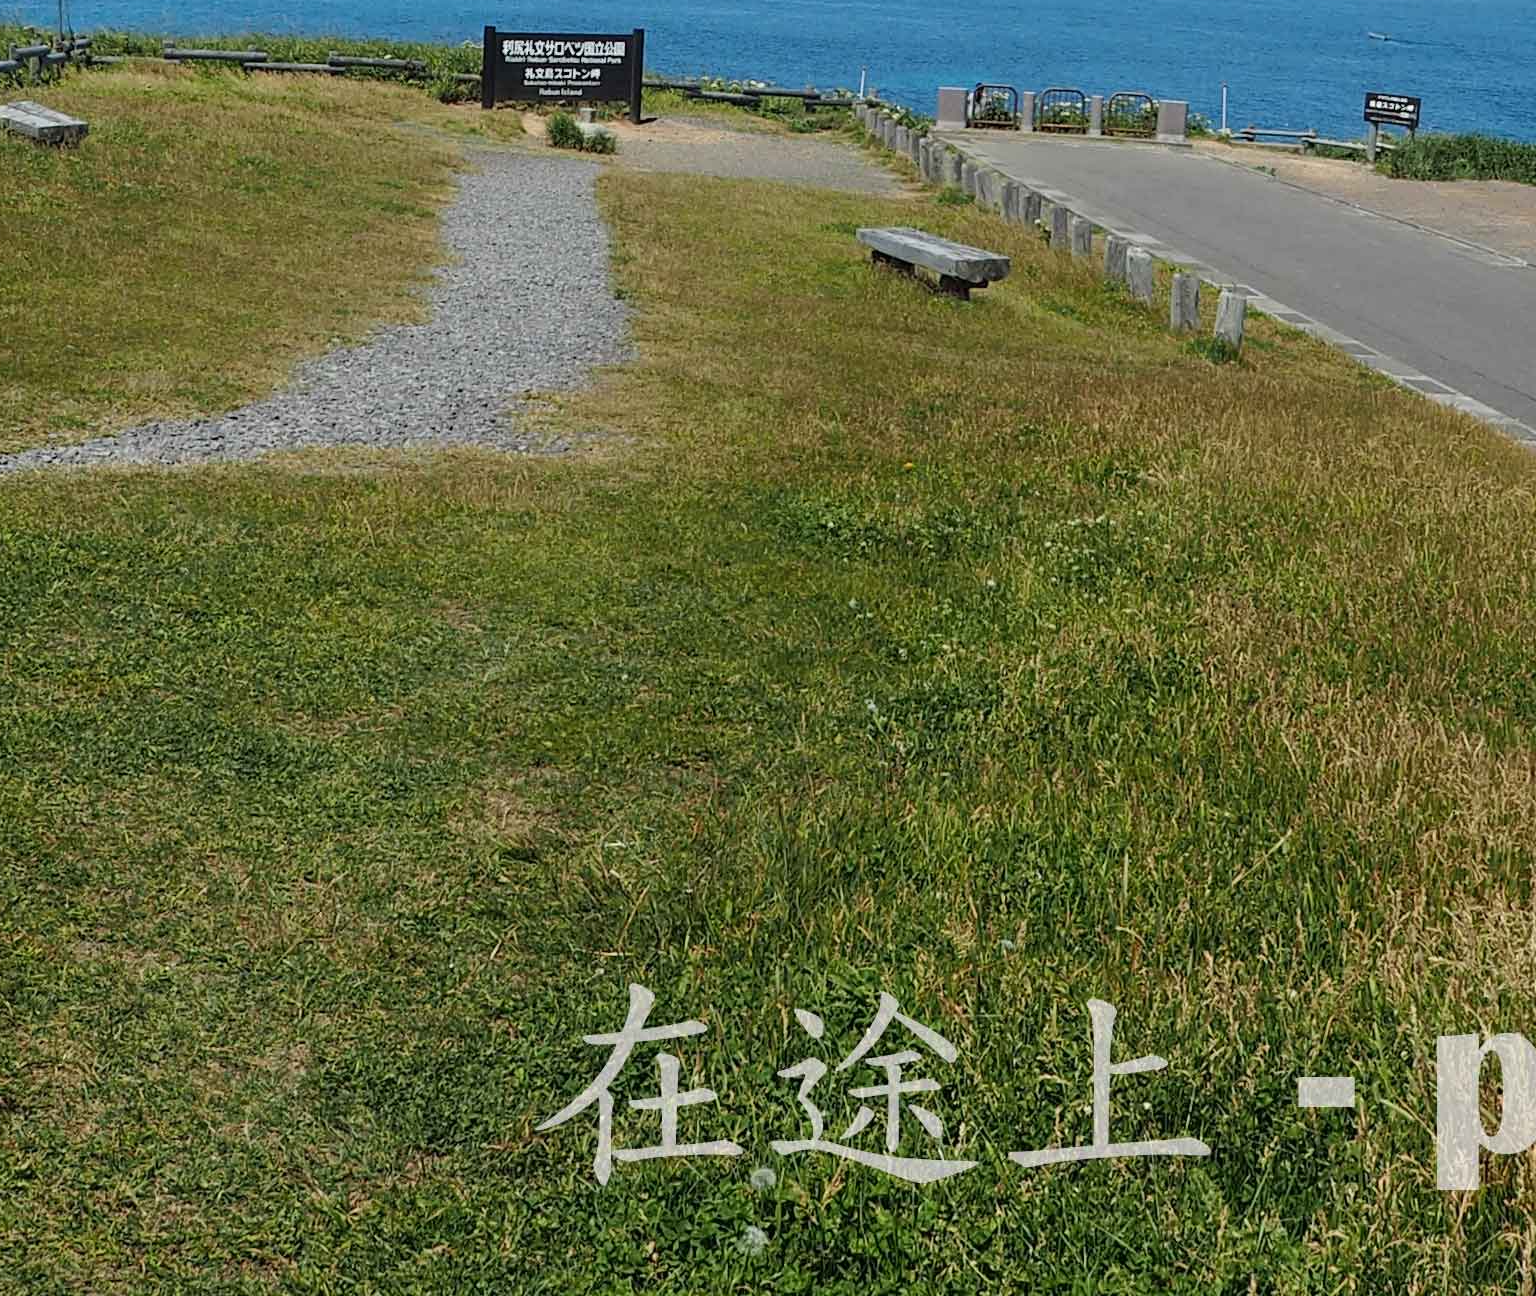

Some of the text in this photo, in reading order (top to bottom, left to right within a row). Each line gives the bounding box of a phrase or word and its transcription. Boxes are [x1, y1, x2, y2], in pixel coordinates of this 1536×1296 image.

[502, 40, 626, 56] 利尻礼文サロベツ国立公園
[524, 68, 601, 80] 礼文島スコトン岬
